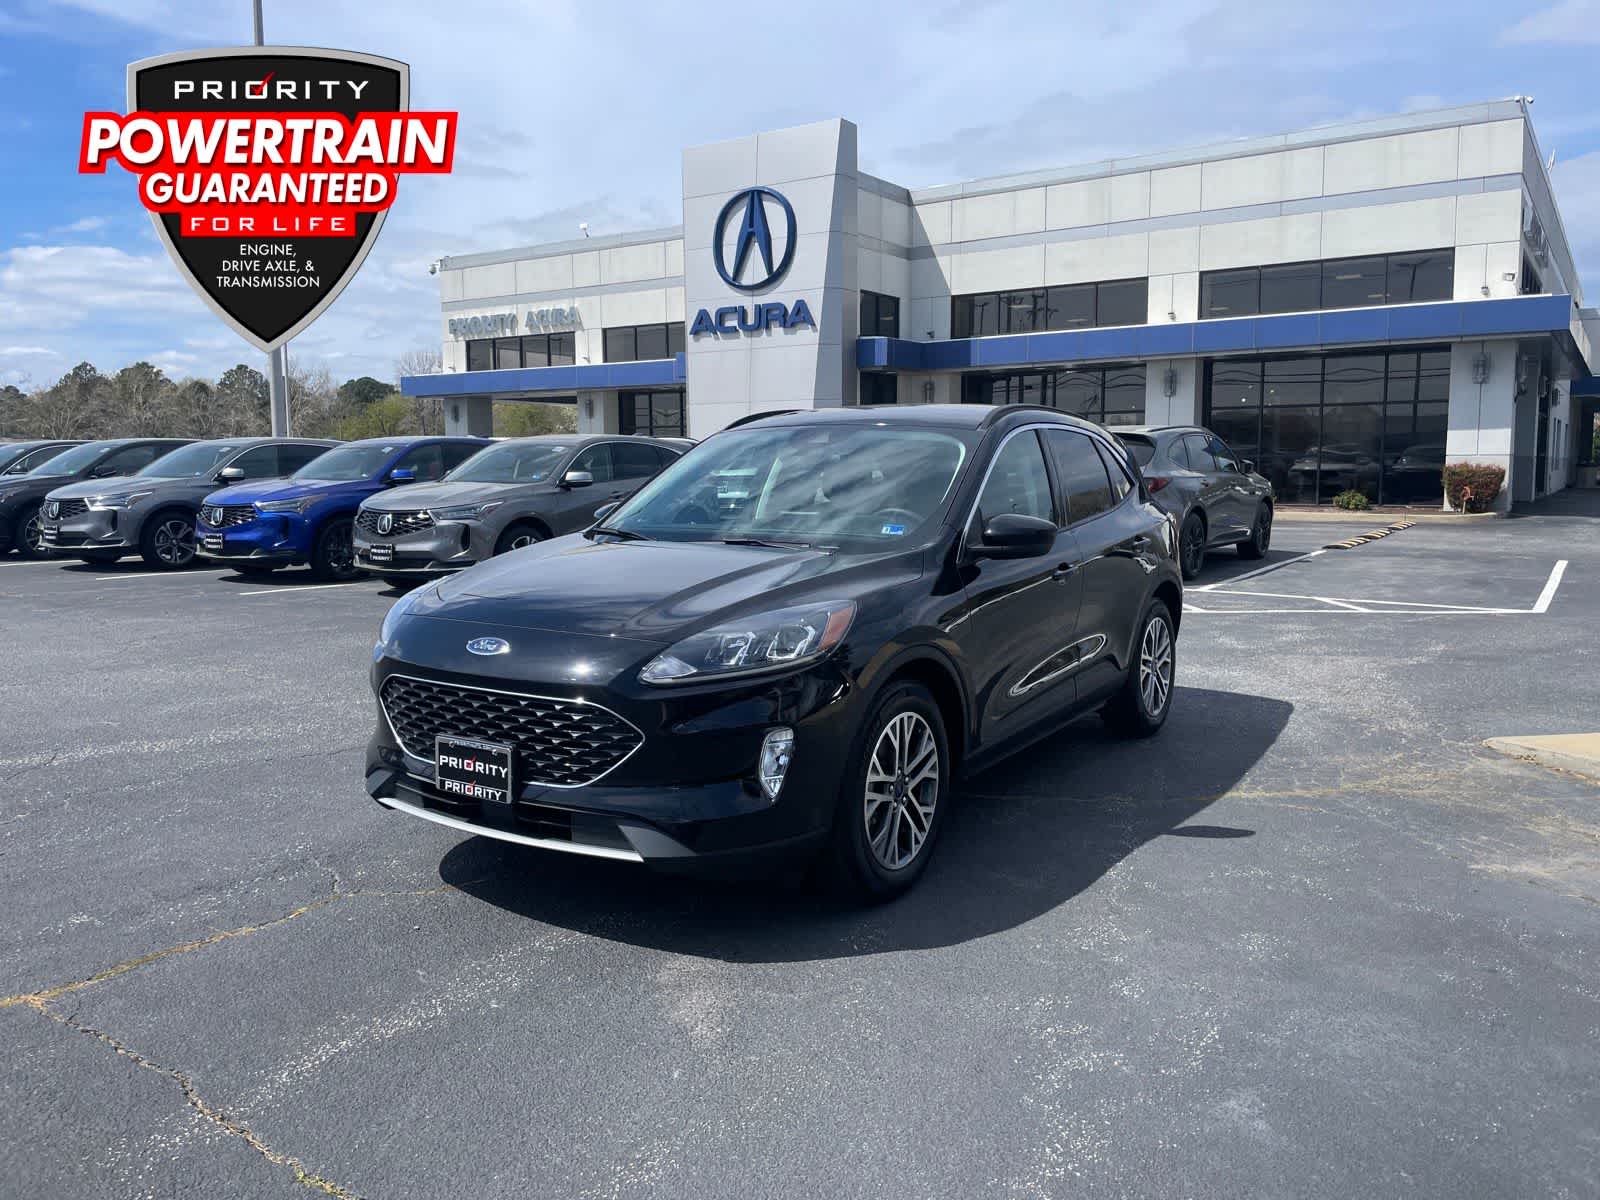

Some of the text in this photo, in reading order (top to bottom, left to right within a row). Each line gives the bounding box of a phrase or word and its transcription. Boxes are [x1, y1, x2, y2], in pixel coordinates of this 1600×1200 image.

[525, 306, 582, 331] ACURA
[689, 299, 817, 336] ACURA
[439, 755, 508, 778] PRIORITY
[444, 780, 502, 801] PRIORITY
